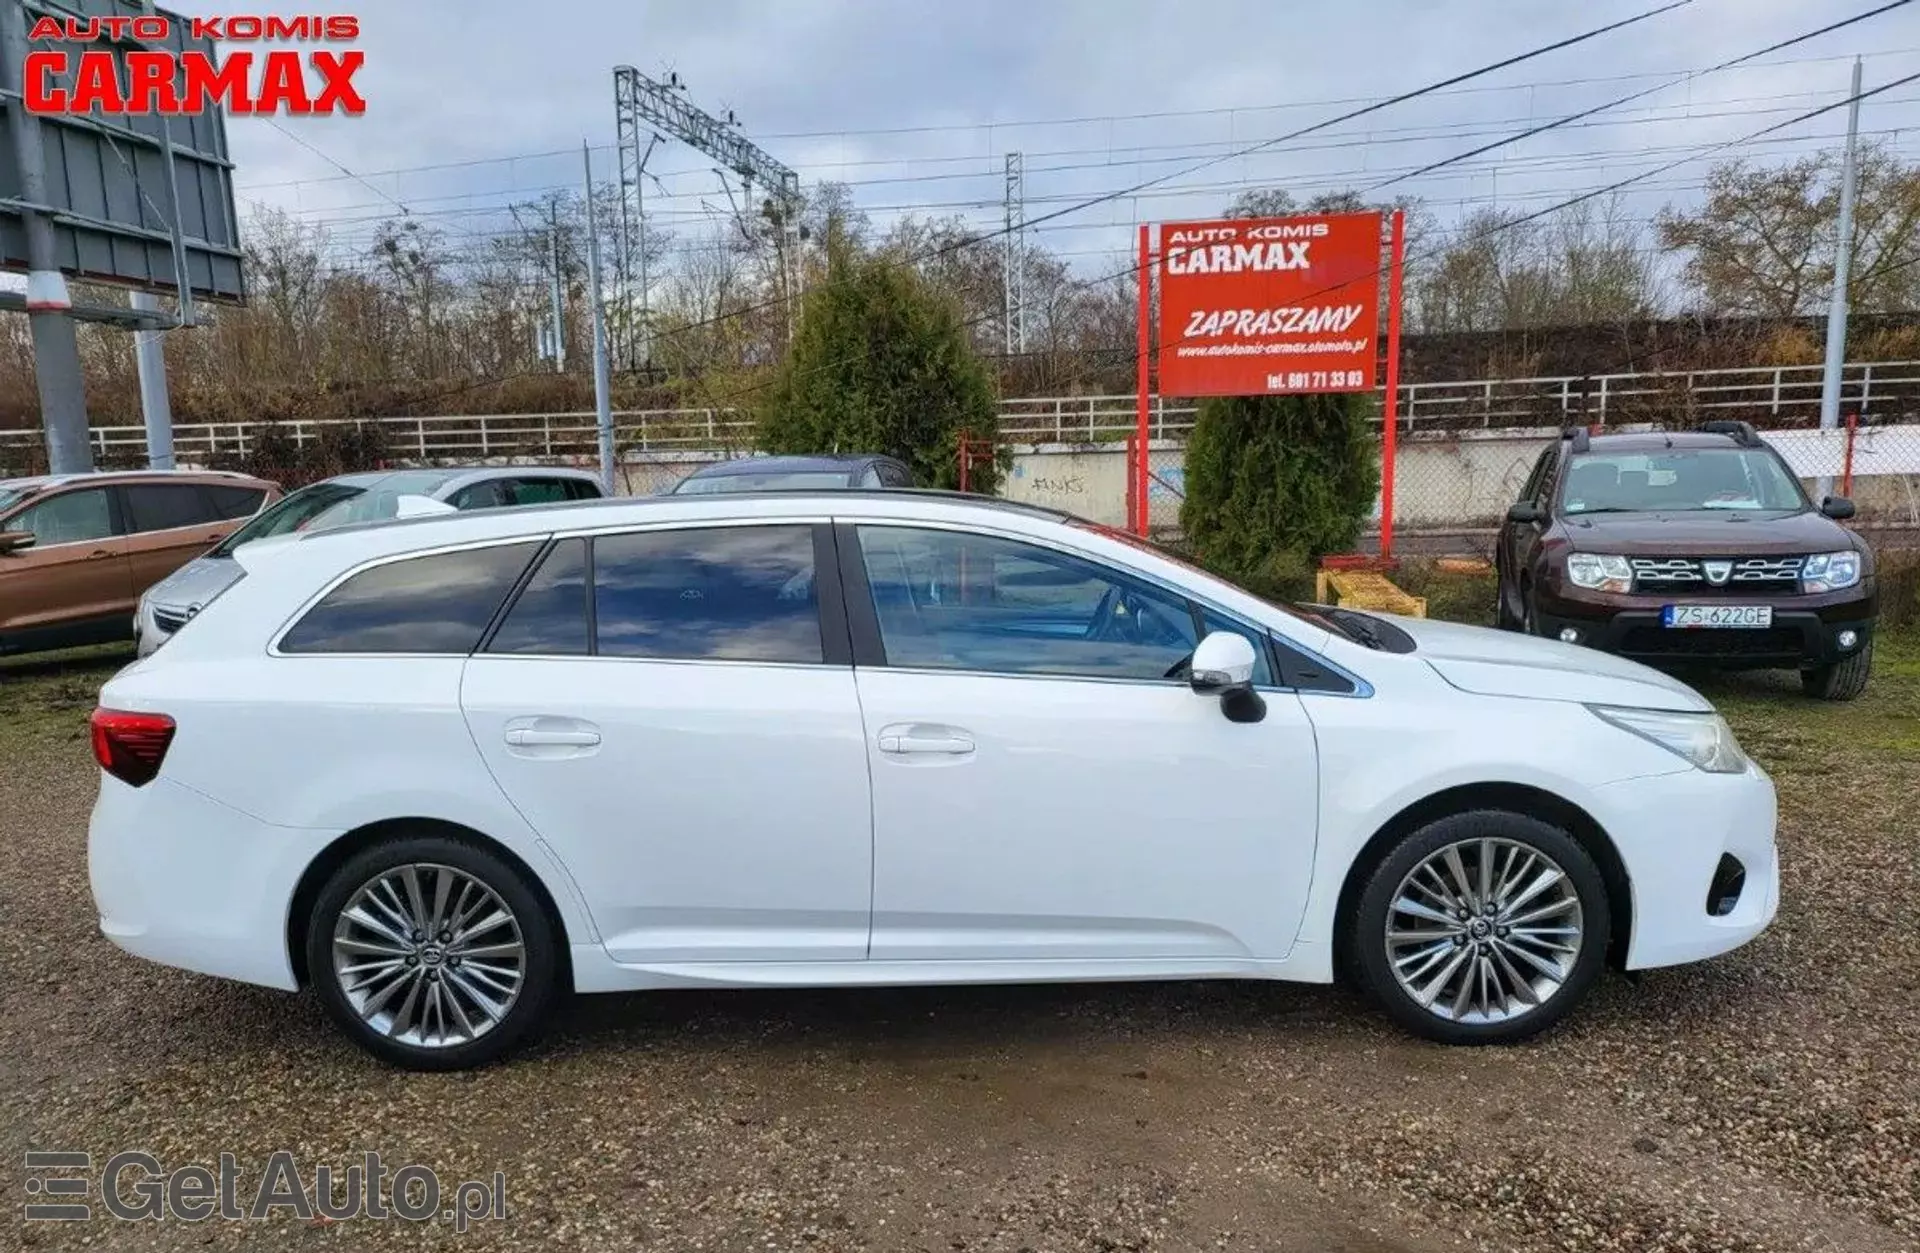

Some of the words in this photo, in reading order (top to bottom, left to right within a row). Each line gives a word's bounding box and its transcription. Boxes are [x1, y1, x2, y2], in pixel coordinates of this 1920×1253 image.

[1169, 228, 1237, 243] AUTO
[1247, 223, 1329, 239] KOMIS
[1168, 241, 1310, 274] CARMAX
[1184, 304, 1363, 338] ZAPRASZAMY
[1266, 373, 1284, 390] tel.
[1312, 371, 1327, 388] 71
[1329, 370, 1345, 388] 33
[1677, 607, 1703, 624] ZS
[1710, 607, 1769, 624] 622GE
